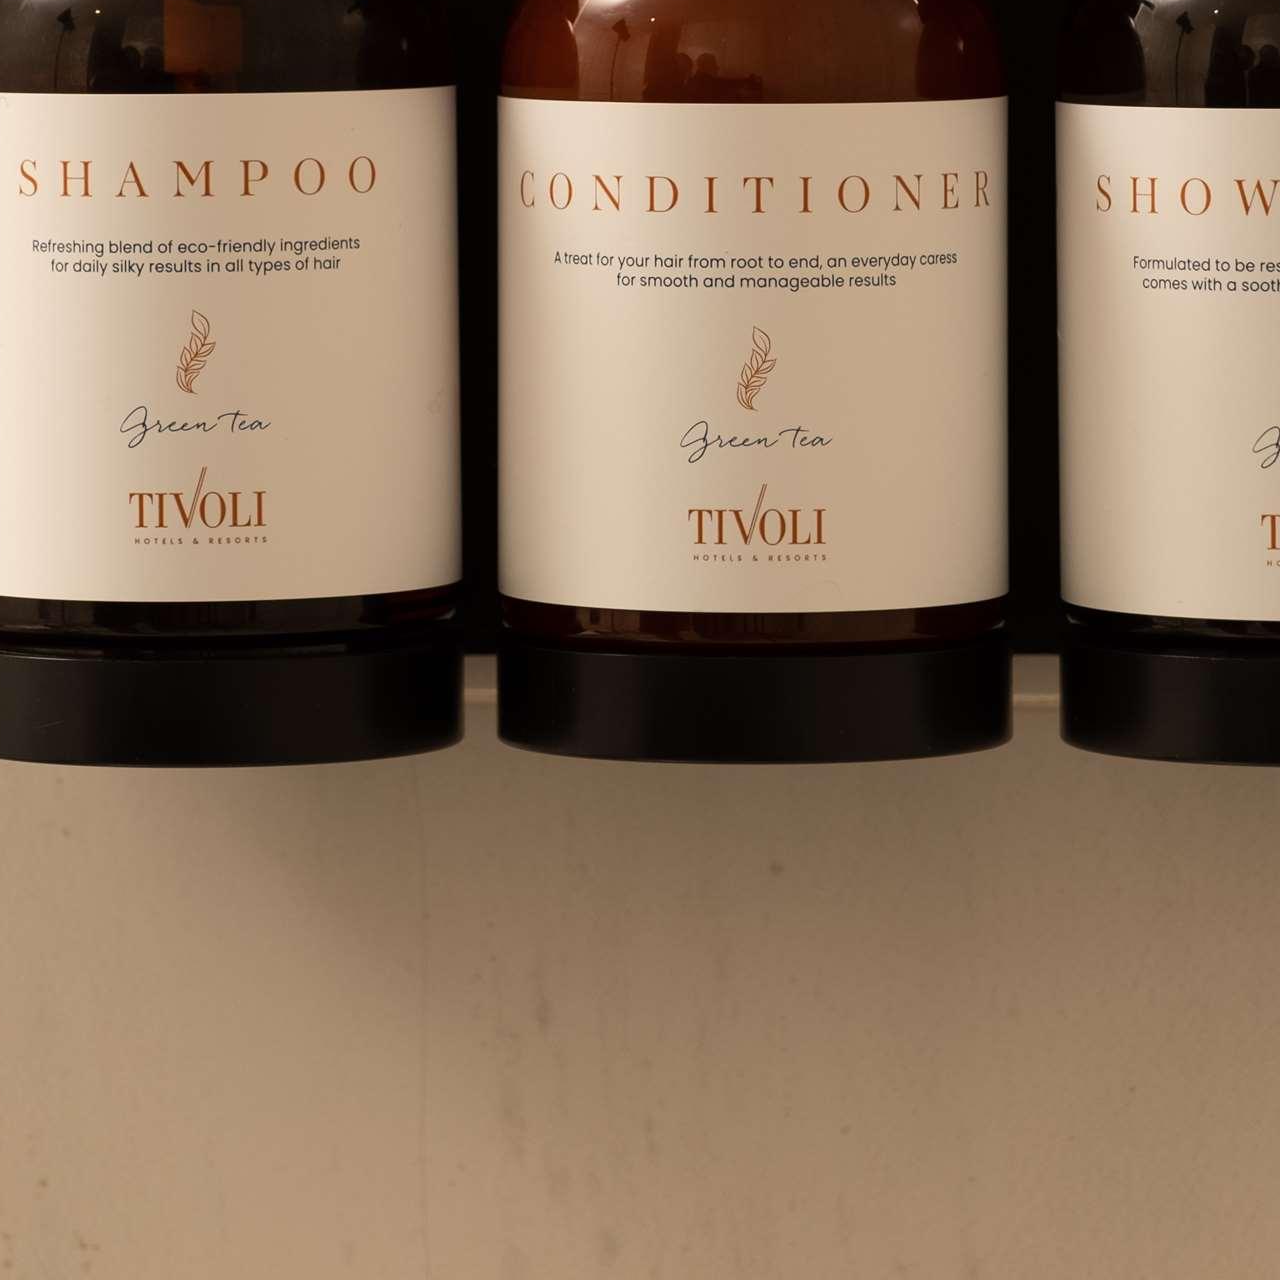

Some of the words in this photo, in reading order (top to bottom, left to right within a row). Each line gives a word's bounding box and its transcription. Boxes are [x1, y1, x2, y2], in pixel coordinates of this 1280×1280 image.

[18, 155, 377, 198] SHAMPOO
[520, 170, 990, 214] CONDITIONER
[32, 239, 105, 258] Refreshing
[108, 239, 153, 255] blend
[157, 239, 174, 254] of
[177, 238, 276, 257] eco-friendly
[279, 235, 361, 256] ingredients
[50, 258, 70, 273] for
[72, 258, 109, 277] daily
[111, 259, 145, 278] silky
[148, 259, 203, 274] results
[206, 258, 221, 273] in
[224, 258, 244, 273] all
[247, 259, 292, 277] types
[294, 255, 310, 271] of
[313, 255, 342, 271] hair
[553, 250, 562, 264] A
[563, 251, 593, 266] treat
[596, 251, 615, 267] for
[617, 255, 651, 271] your
[654, 253, 685, 269] hair
[687, 253, 726, 270] from
[730, 255, 765, 270] root
[767, 255, 785, 270] to
[788, 254, 823, 271] end,
[826, 256, 848, 269] an
[850, 252, 917, 272] everyday
[919, 252, 958, 266] caress
[1133, 255, 1211, 272] Formulated
[1214, 258, 1231, 273] to
[1234, 258, 1256, 273] be
[616, 272, 637, 287] for
[639, 273, 699, 289] smooth
[702, 274, 736, 289] and
[739, 273, 845, 293] manageable
[848, 272, 897, 288] results
[1142, 277, 1188, 291] comes
[1191, 276, 1223, 292] with
[1226, 280, 1237, 292] a
[120, 406, 217, 449] Green
[680, 421, 778, 464] Green
[128, 465, 268, 529] TIVOLI
[687, 482, 827, 547] TIVOLI
[134, 537, 184, 545] HOTELS
[208, 535, 268, 545] RESORTS
[693, 553, 743, 563] HOTELS
[767, 553, 827, 562] RESORTS
